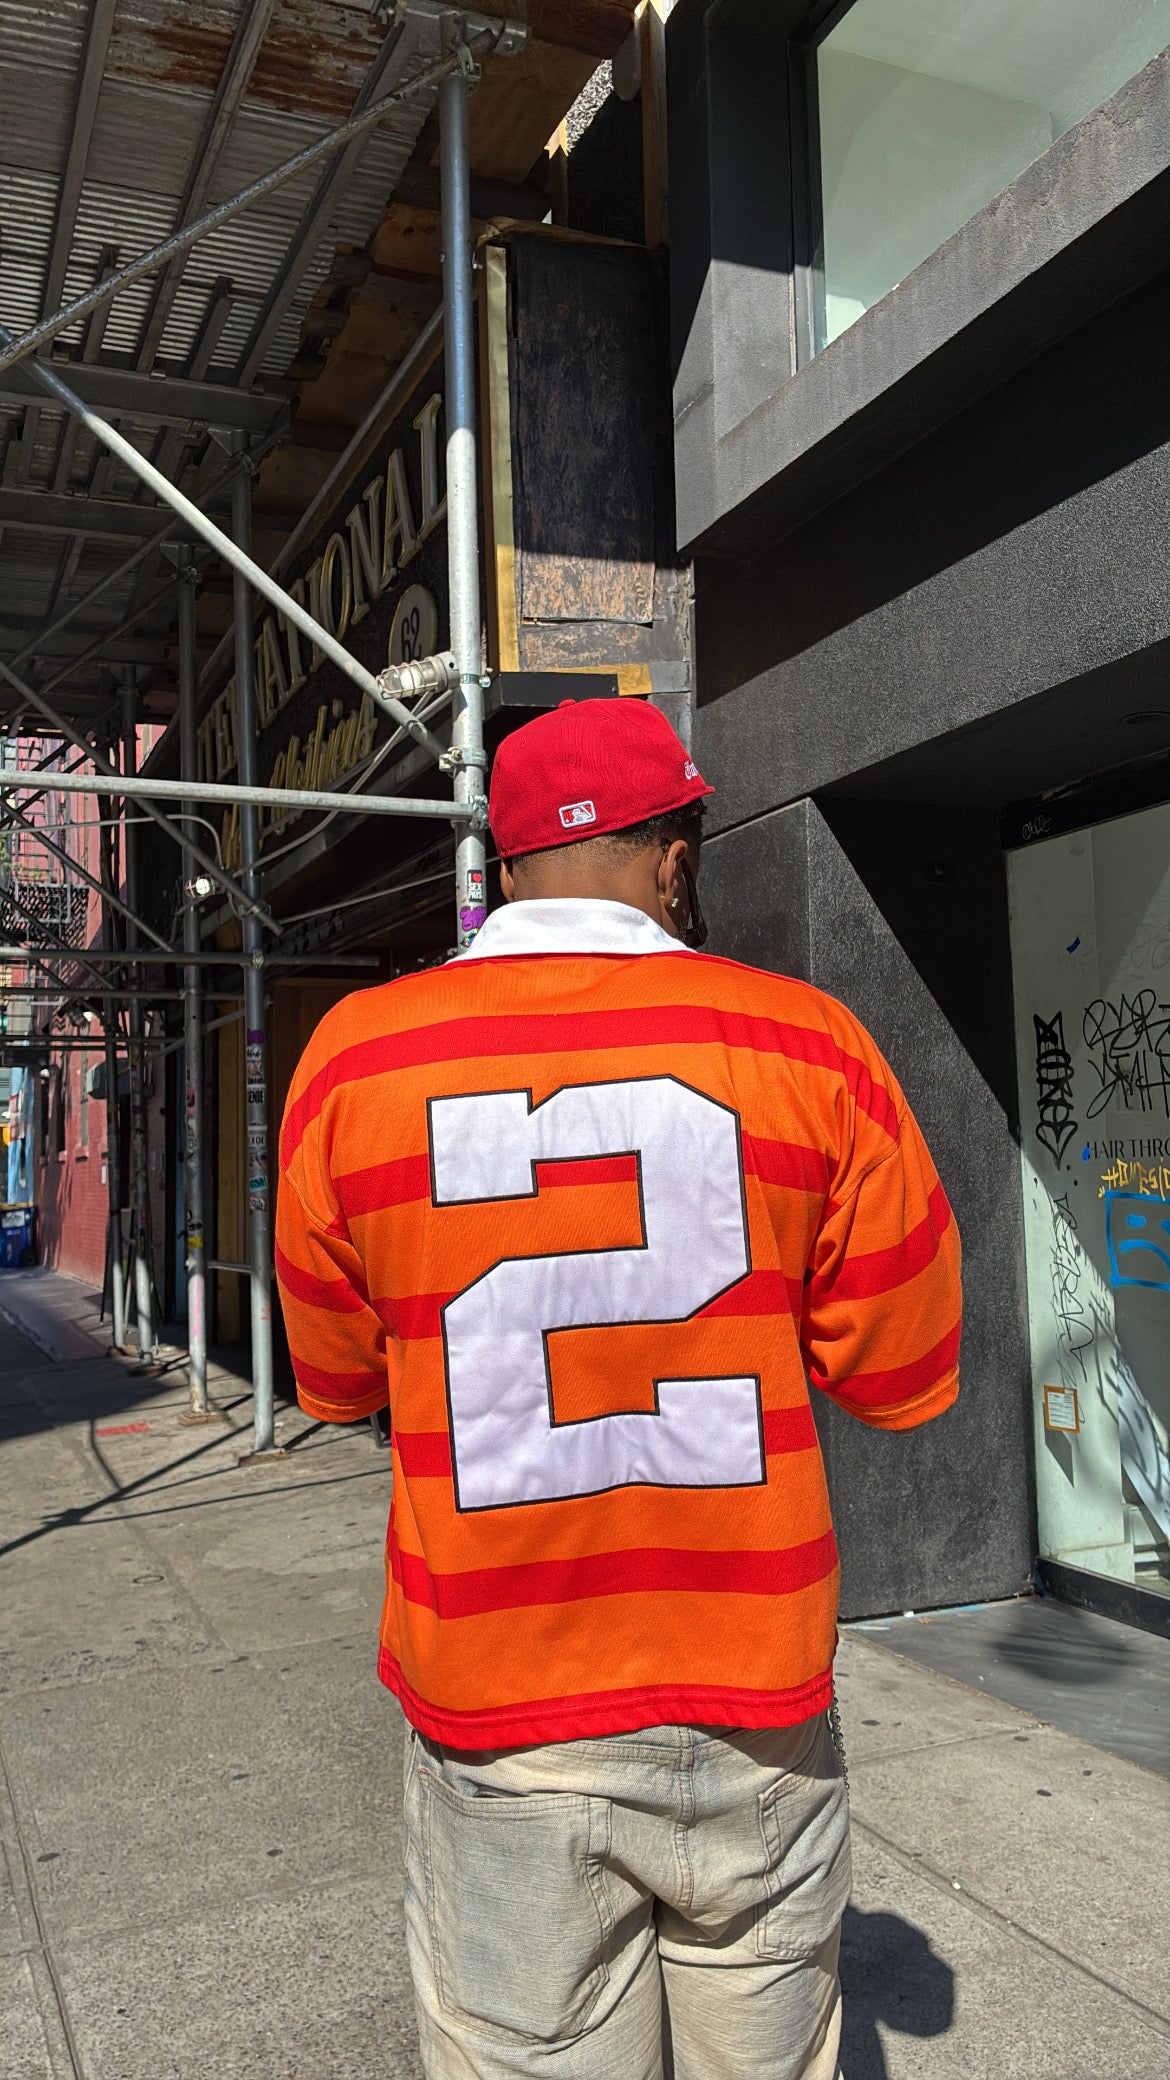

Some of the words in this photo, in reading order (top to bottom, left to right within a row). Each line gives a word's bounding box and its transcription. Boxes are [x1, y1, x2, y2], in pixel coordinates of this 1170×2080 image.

[398, 606, 421, 662] 62
[1086, 1140, 1125, 1159] HAIR
[427, 1073, 768, 1513] 2
